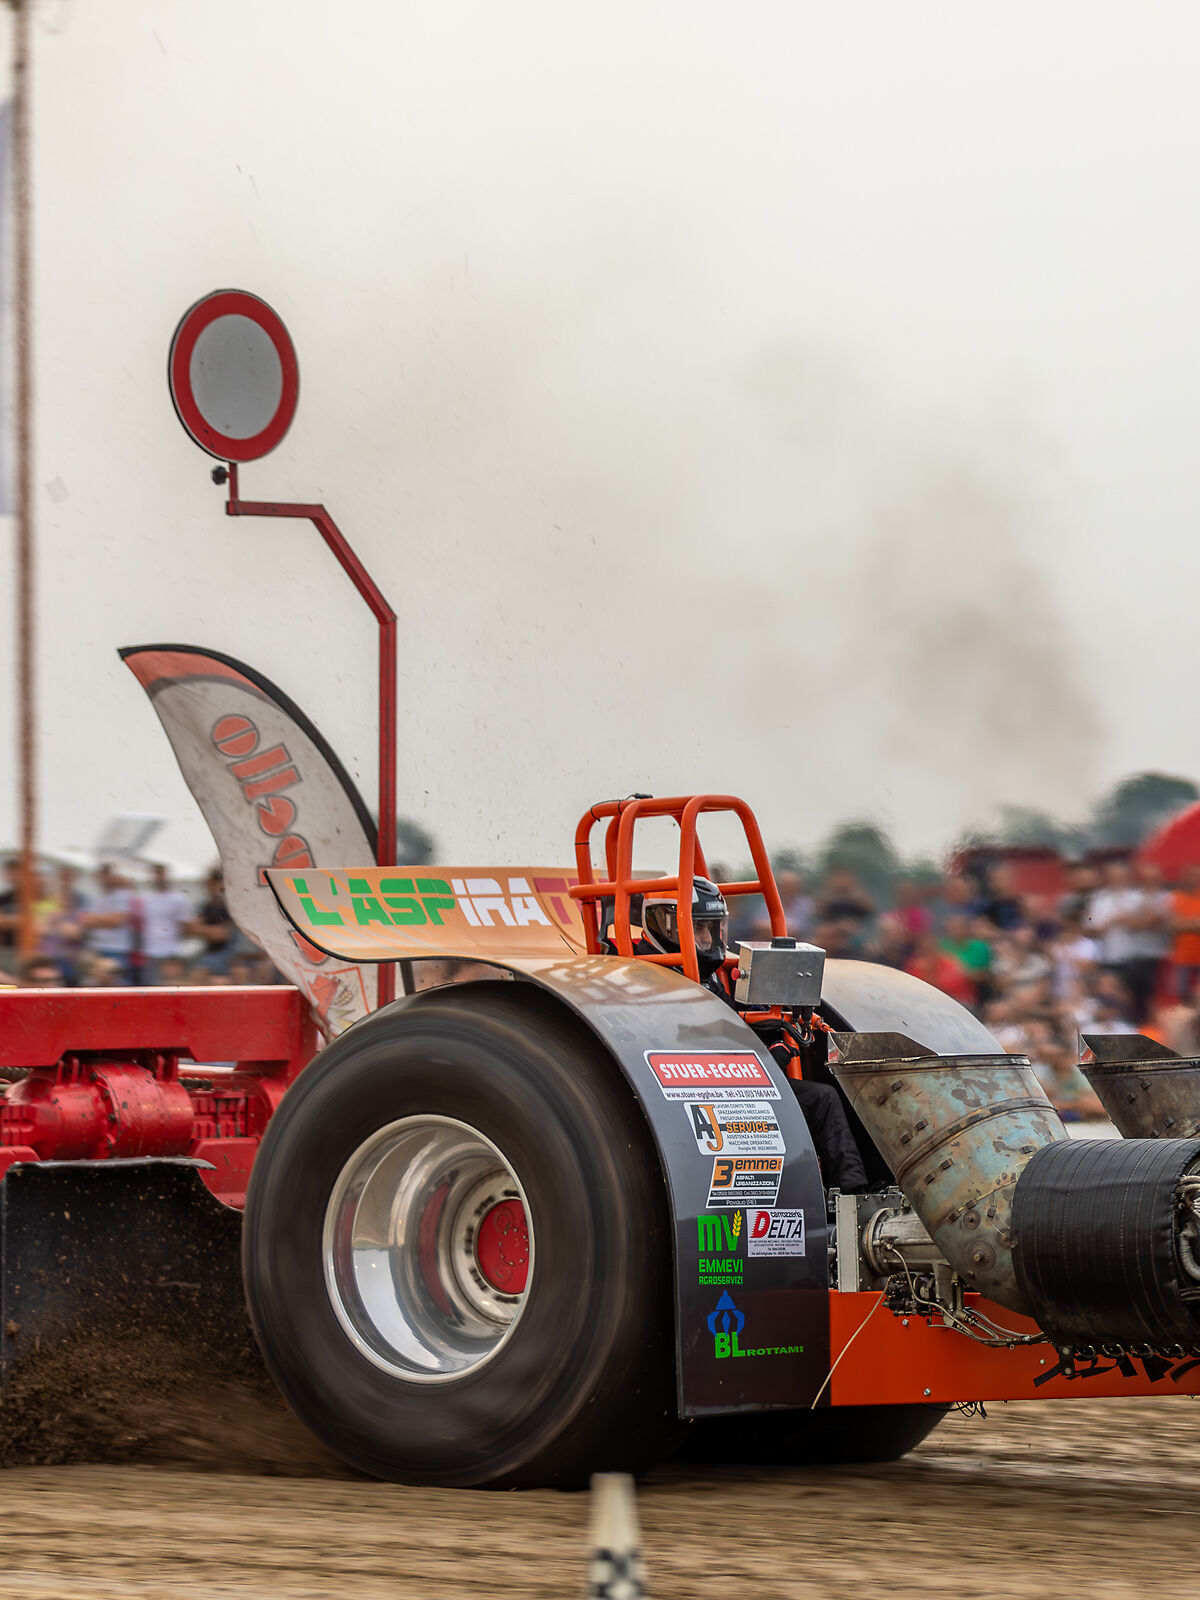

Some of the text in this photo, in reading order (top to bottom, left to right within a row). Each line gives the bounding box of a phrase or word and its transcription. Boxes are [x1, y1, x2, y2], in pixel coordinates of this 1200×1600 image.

[659, 1063, 762, 1079] STUER-EGGHE
[666, 1091, 724, 1099] www.stuer-egghe.be
[690, 1104, 724, 1151] AJ
[725, 1121, 769, 1133] SERVICE
[749, 1211, 803, 1239] DELTA
[698, 1259, 743, 1272] EMMEVI
